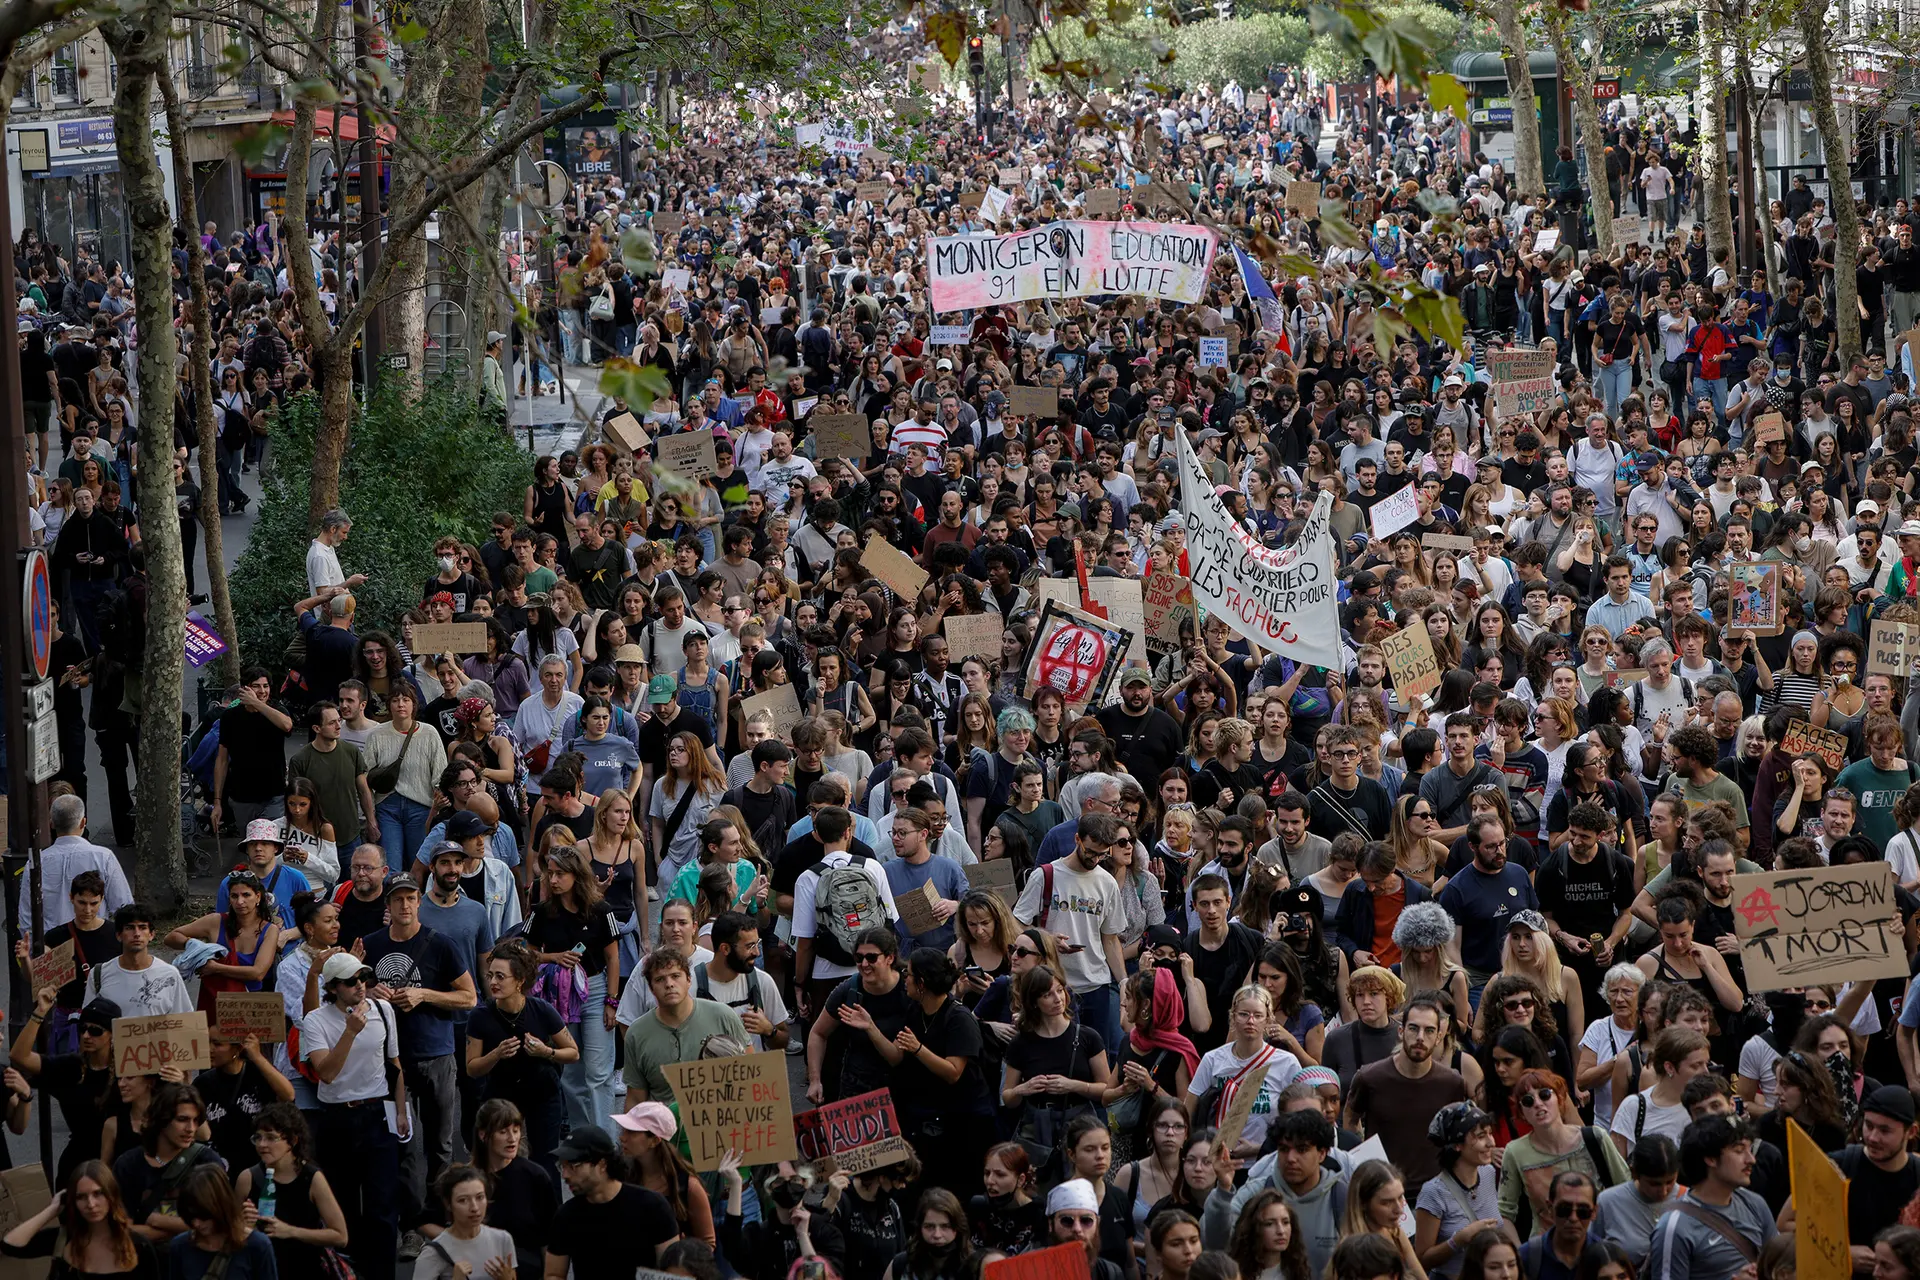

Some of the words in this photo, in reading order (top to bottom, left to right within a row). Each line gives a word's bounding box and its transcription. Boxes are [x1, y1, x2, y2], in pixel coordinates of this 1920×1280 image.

[1489, 112, 1511, 121] Voltaire
[21, 147, 45, 157] feyrouz
[575, 161, 612, 173] LIBRE
[936, 228, 1084, 276] MONTGERON
[1111, 230, 1207, 268] EDUCATION
[1044, 267, 1080, 292] EN
[1103, 266, 1174, 295] LUTTE
[1501, 383, 1515, 396] LA
[1517, 389, 1553, 401] BOUCHE
[1517, 398, 1550, 413] ADOS
[1151, 573, 1176, 592] SOIS
[1191, 556, 1224, 599] LES
[1146, 589, 1174, 609] JEUNE
[1300, 584, 1329, 607] POUR
[1153, 609, 1164, 618] ET
[189, 634, 216, 655] L'ÉCOLE
[196, 629, 209, 639] DE
[205, 636, 222, 649] FRIC
[1382, 631, 1413, 658] DES
[1395, 643, 1425, 668] COURS
[1876, 650, 1901, 666] PLUS
[1392, 664, 1416, 689] PAS
[1415, 654, 1437, 678] DES
[1404, 673, 1437, 700] COUPS
[1782, 734, 1802, 753] PAS
[1565, 882, 1604, 892] MICHEL
[1785, 918, 1895, 962] MORT
[680, 1067, 706, 1089] LES
[711, 1061, 762, 1084] LYCÉENS
[752, 1081, 781, 1102] BAC
[691, 1109, 712, 1127] LA
[717, 1107, 741, 1127] BAC
[744, 1105, 774, 1123] VISE
[701, 1130, 727, 1161] LA
